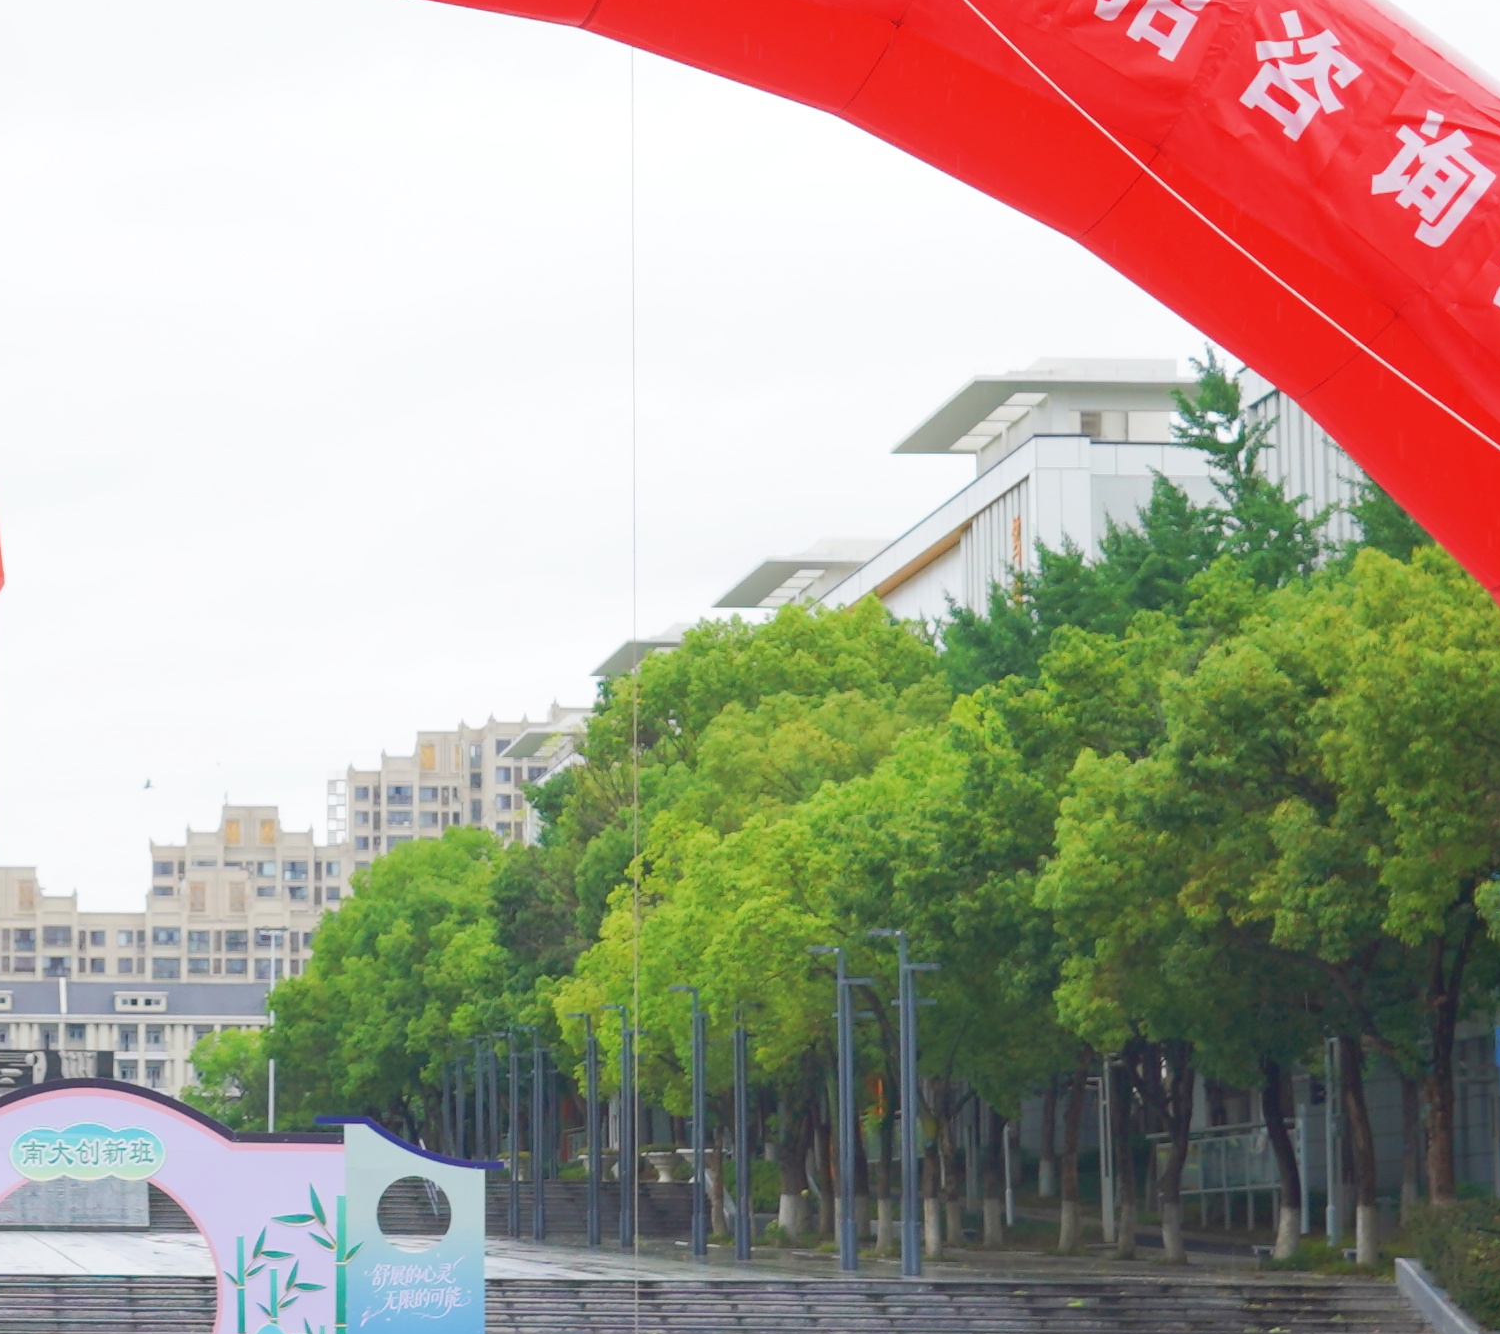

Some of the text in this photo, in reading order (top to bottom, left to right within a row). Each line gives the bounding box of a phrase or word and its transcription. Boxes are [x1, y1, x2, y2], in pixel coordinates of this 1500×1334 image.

[20, 1139, 155, 1166] 南大创新班
[371, 1261, 459, 1293] 舒展的心灵
[380, 1285, 466, 1316] 无限的可能
